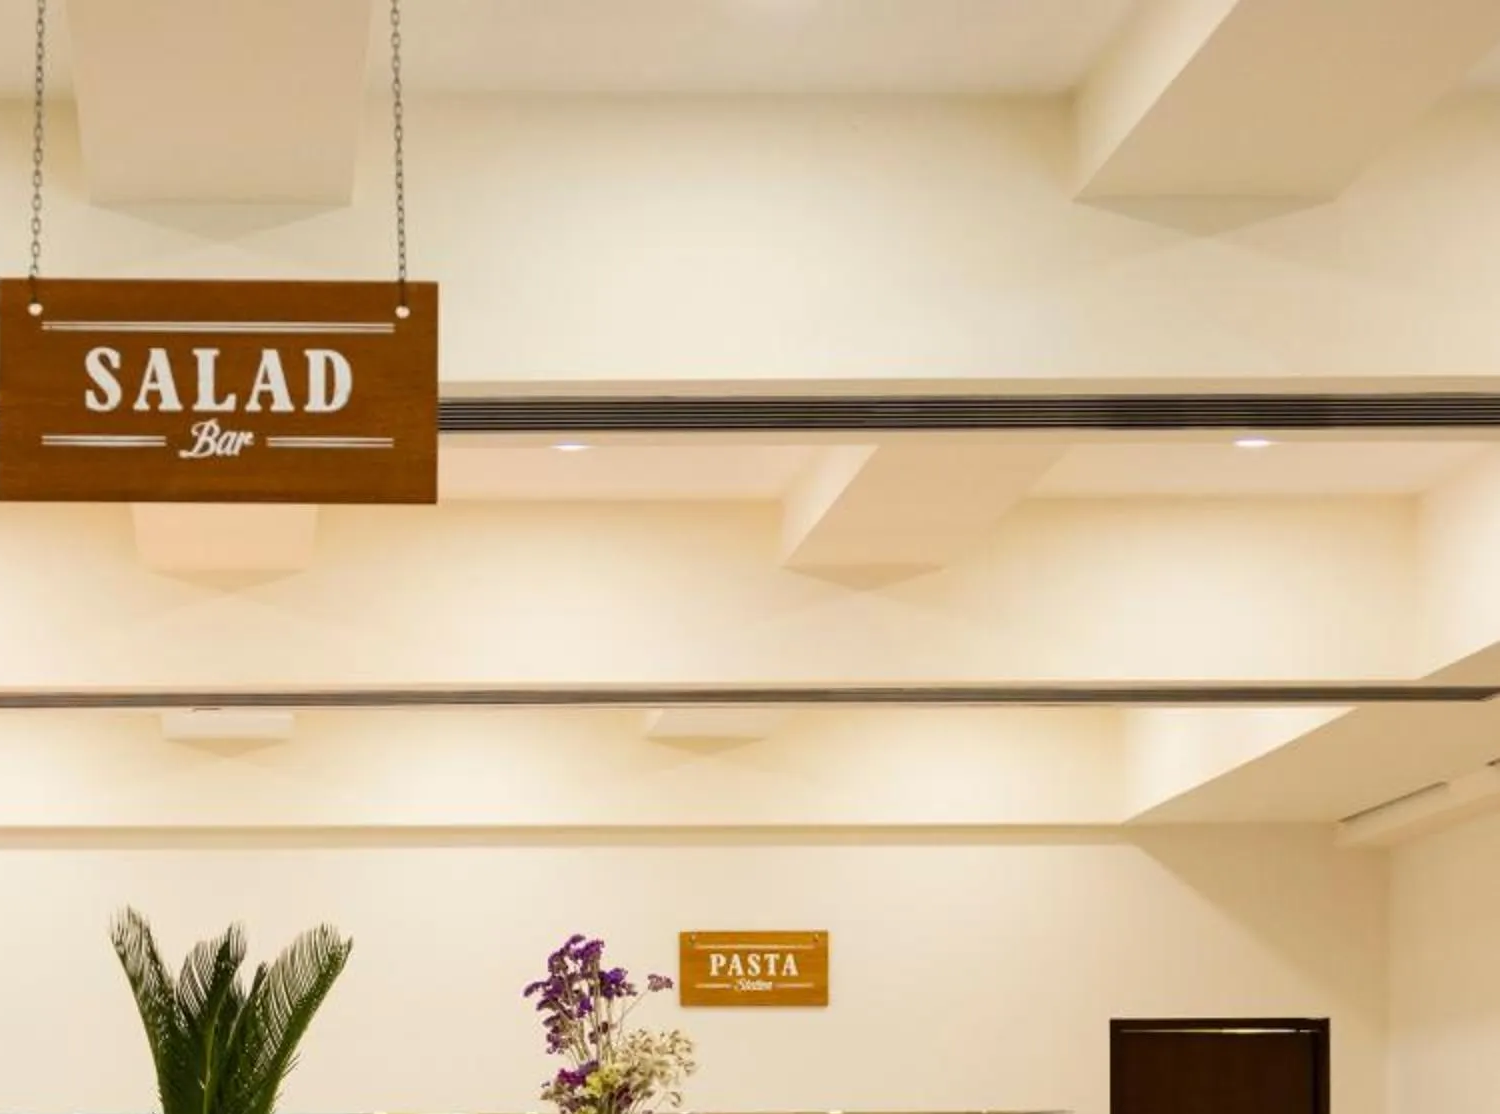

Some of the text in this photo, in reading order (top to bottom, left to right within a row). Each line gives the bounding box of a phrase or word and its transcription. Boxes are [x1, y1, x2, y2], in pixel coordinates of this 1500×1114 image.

[85, 346, 353, 413] SALAD
[179, 418, 254, 459] Bar
[709, 953, 799, 977] PASTA
